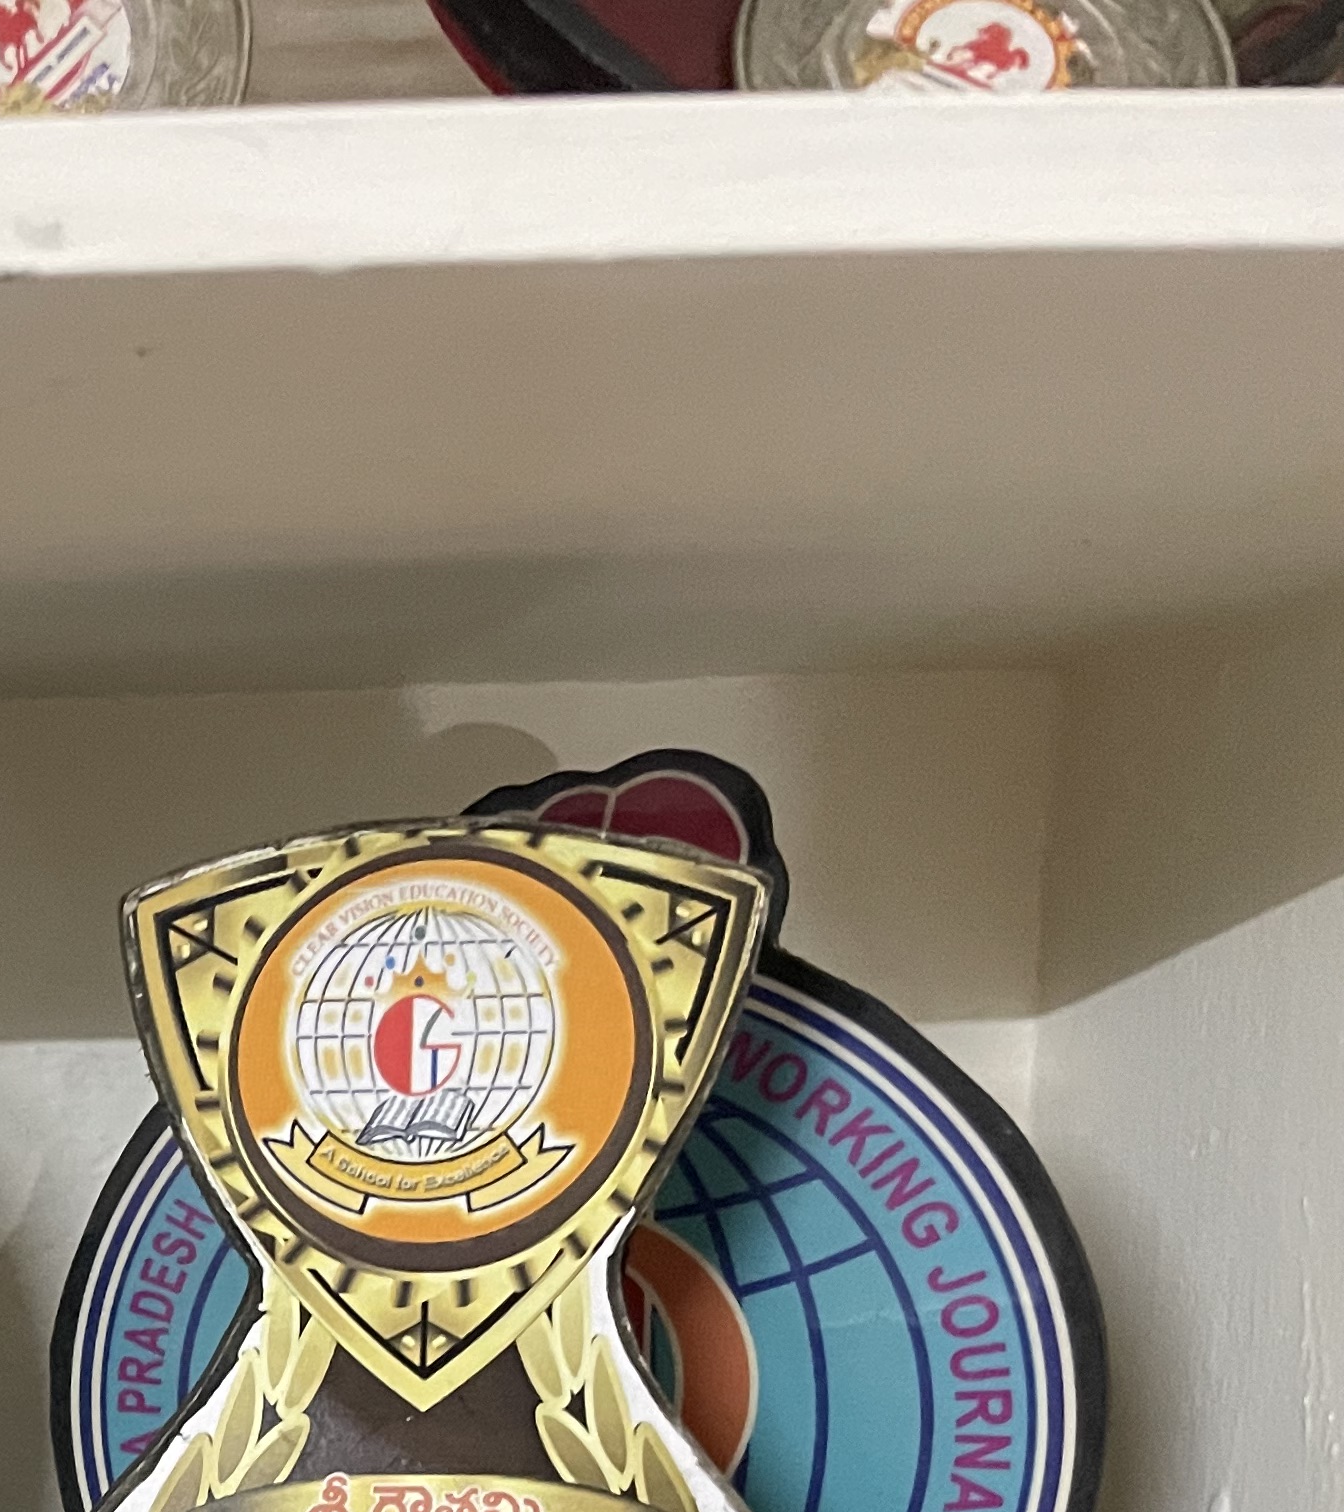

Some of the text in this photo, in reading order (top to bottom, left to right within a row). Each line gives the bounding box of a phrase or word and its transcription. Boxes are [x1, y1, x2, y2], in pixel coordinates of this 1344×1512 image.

[291, 883, 559, 976] CLEAR VISION EDUCATION SOCIETY
[320, 1145, 510, 1192] A School for Excellence
[117, 1198, 215, 1415] PRADESH
